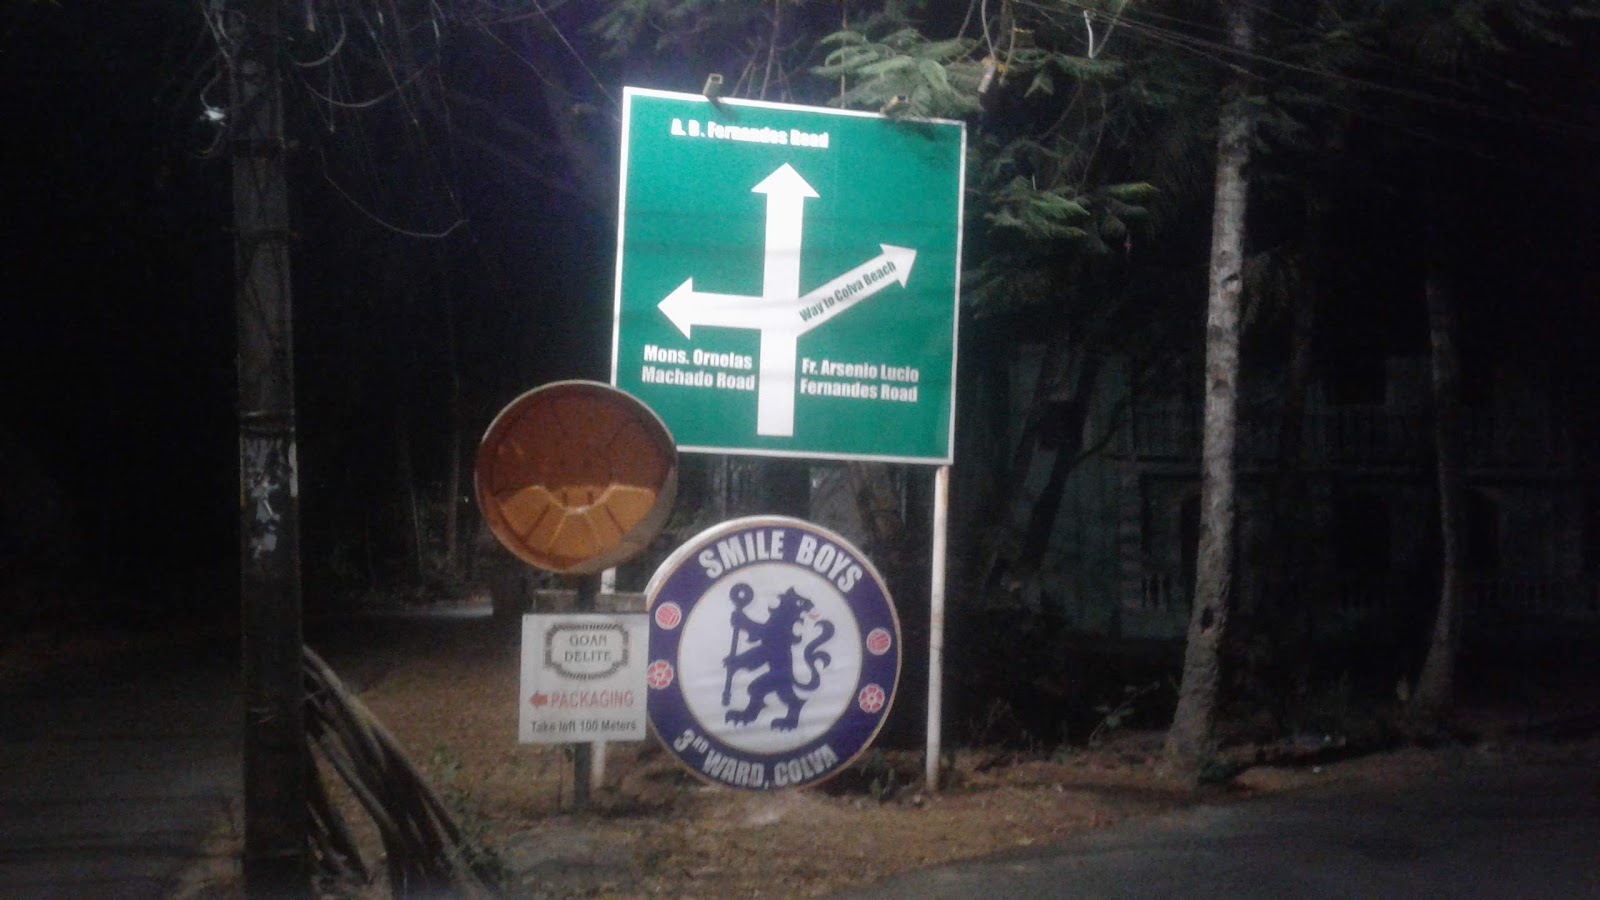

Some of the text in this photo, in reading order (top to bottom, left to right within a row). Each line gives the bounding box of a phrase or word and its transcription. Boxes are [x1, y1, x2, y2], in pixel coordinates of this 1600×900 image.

[707, 121, 788, 145] Fernandes
[790, 129, 830, 149] Road
[799, 260, 897, 322] Way to Colva Beach
[643, 344, 753, 370] Mons. Ornelas
[801, 357, 920, 383] Fr. Arsenio Lucio
[641, 365, 756, 391] Machado Road
[800, 377, 919, 403] Fernandes Road
[698, 529, 863, 593] SMILE BOYS
[569, 634, 608, 647] GOAN
[564, 650, 611, 662] DELITE
[550, 689, 634, 710] PACKAGING
[531, 719, 637, 733] Take left 100 Meters
[702, 749, 769, 790] WARD,
[774, 743, 838, 786] COLVA
